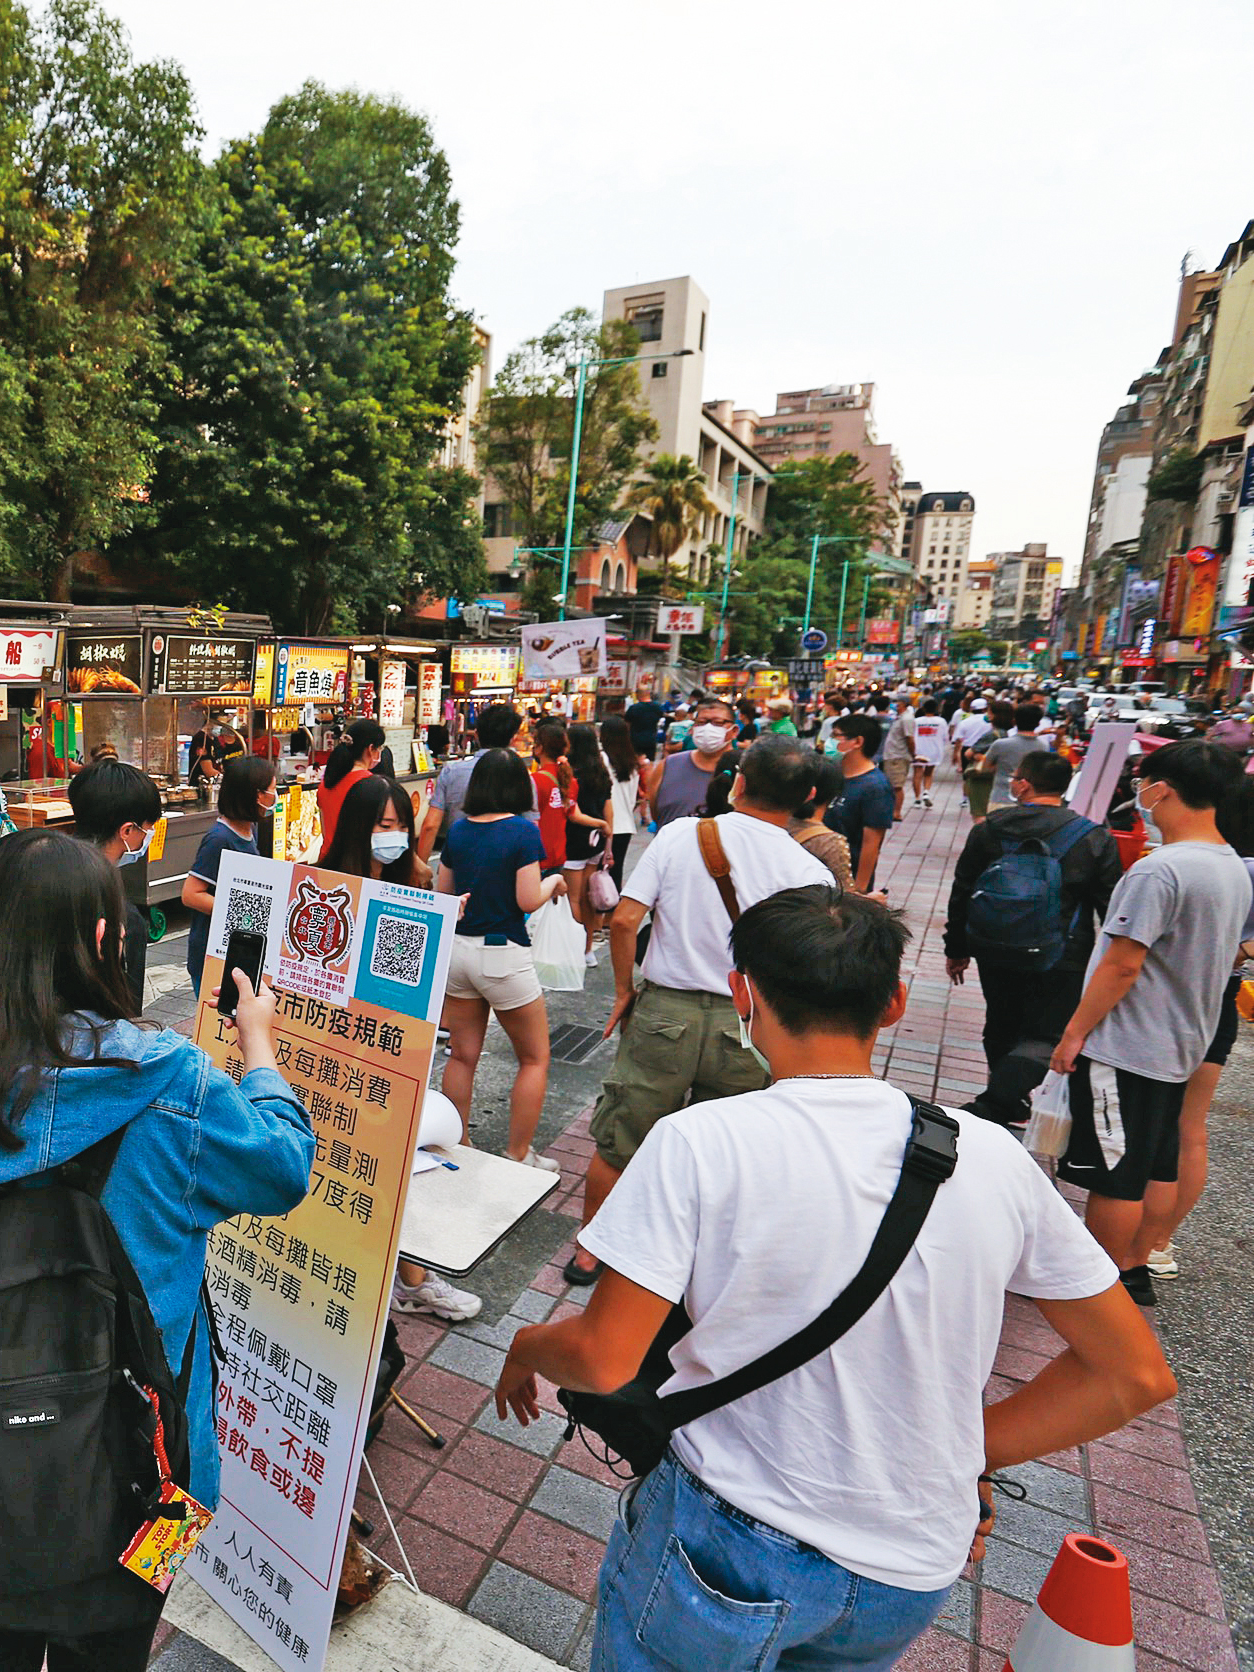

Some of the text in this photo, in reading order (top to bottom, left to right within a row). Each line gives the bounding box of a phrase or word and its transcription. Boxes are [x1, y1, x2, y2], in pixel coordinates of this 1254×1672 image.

[80, 643, 126, 662] 胡椒蝦
[547, 639, 585, 660] BUBBLE TEA
[295, 669, 333, 697] 章魚燒
[301, 905, 329, 956] 寧夏
[8, 1415, 27, 1425] niko
[29, 1412, 46, 1423] and
[152, 1523, 166, 1542] TOY
[154, 1522, 175, 1551] STORY
[213, 1556, 311, 1664] 關心您的健康
